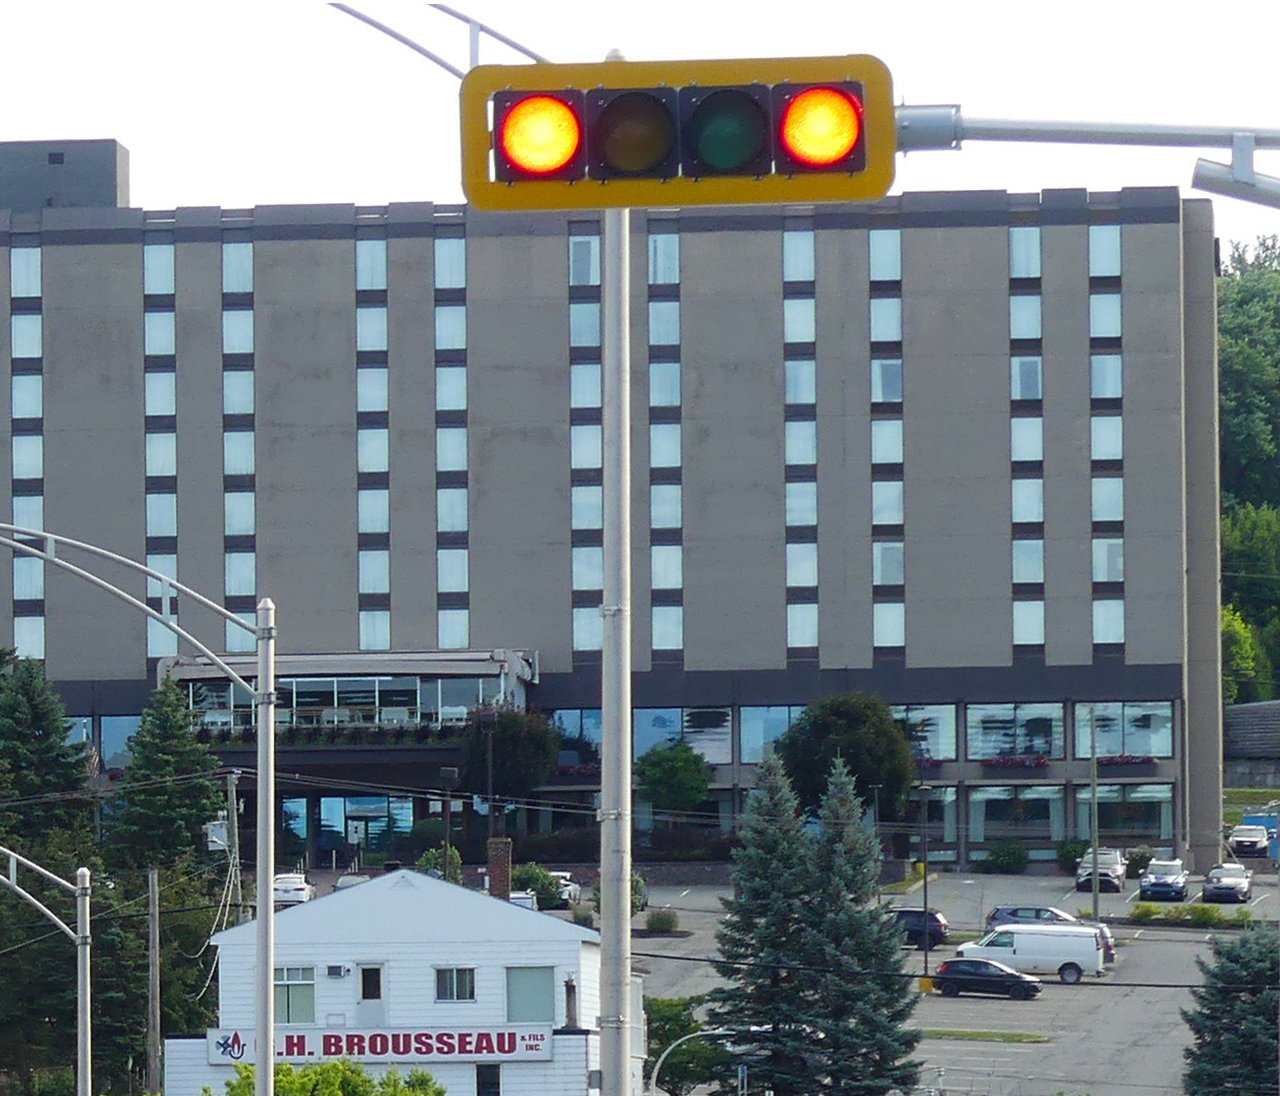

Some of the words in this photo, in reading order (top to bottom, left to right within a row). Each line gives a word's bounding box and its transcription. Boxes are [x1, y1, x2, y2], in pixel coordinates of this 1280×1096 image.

[322, 1031, 517, 1056] BROUSSEAU
[528, 1033, 546, 1042] FILS
[524, 1043, 543, 1052] INC.
